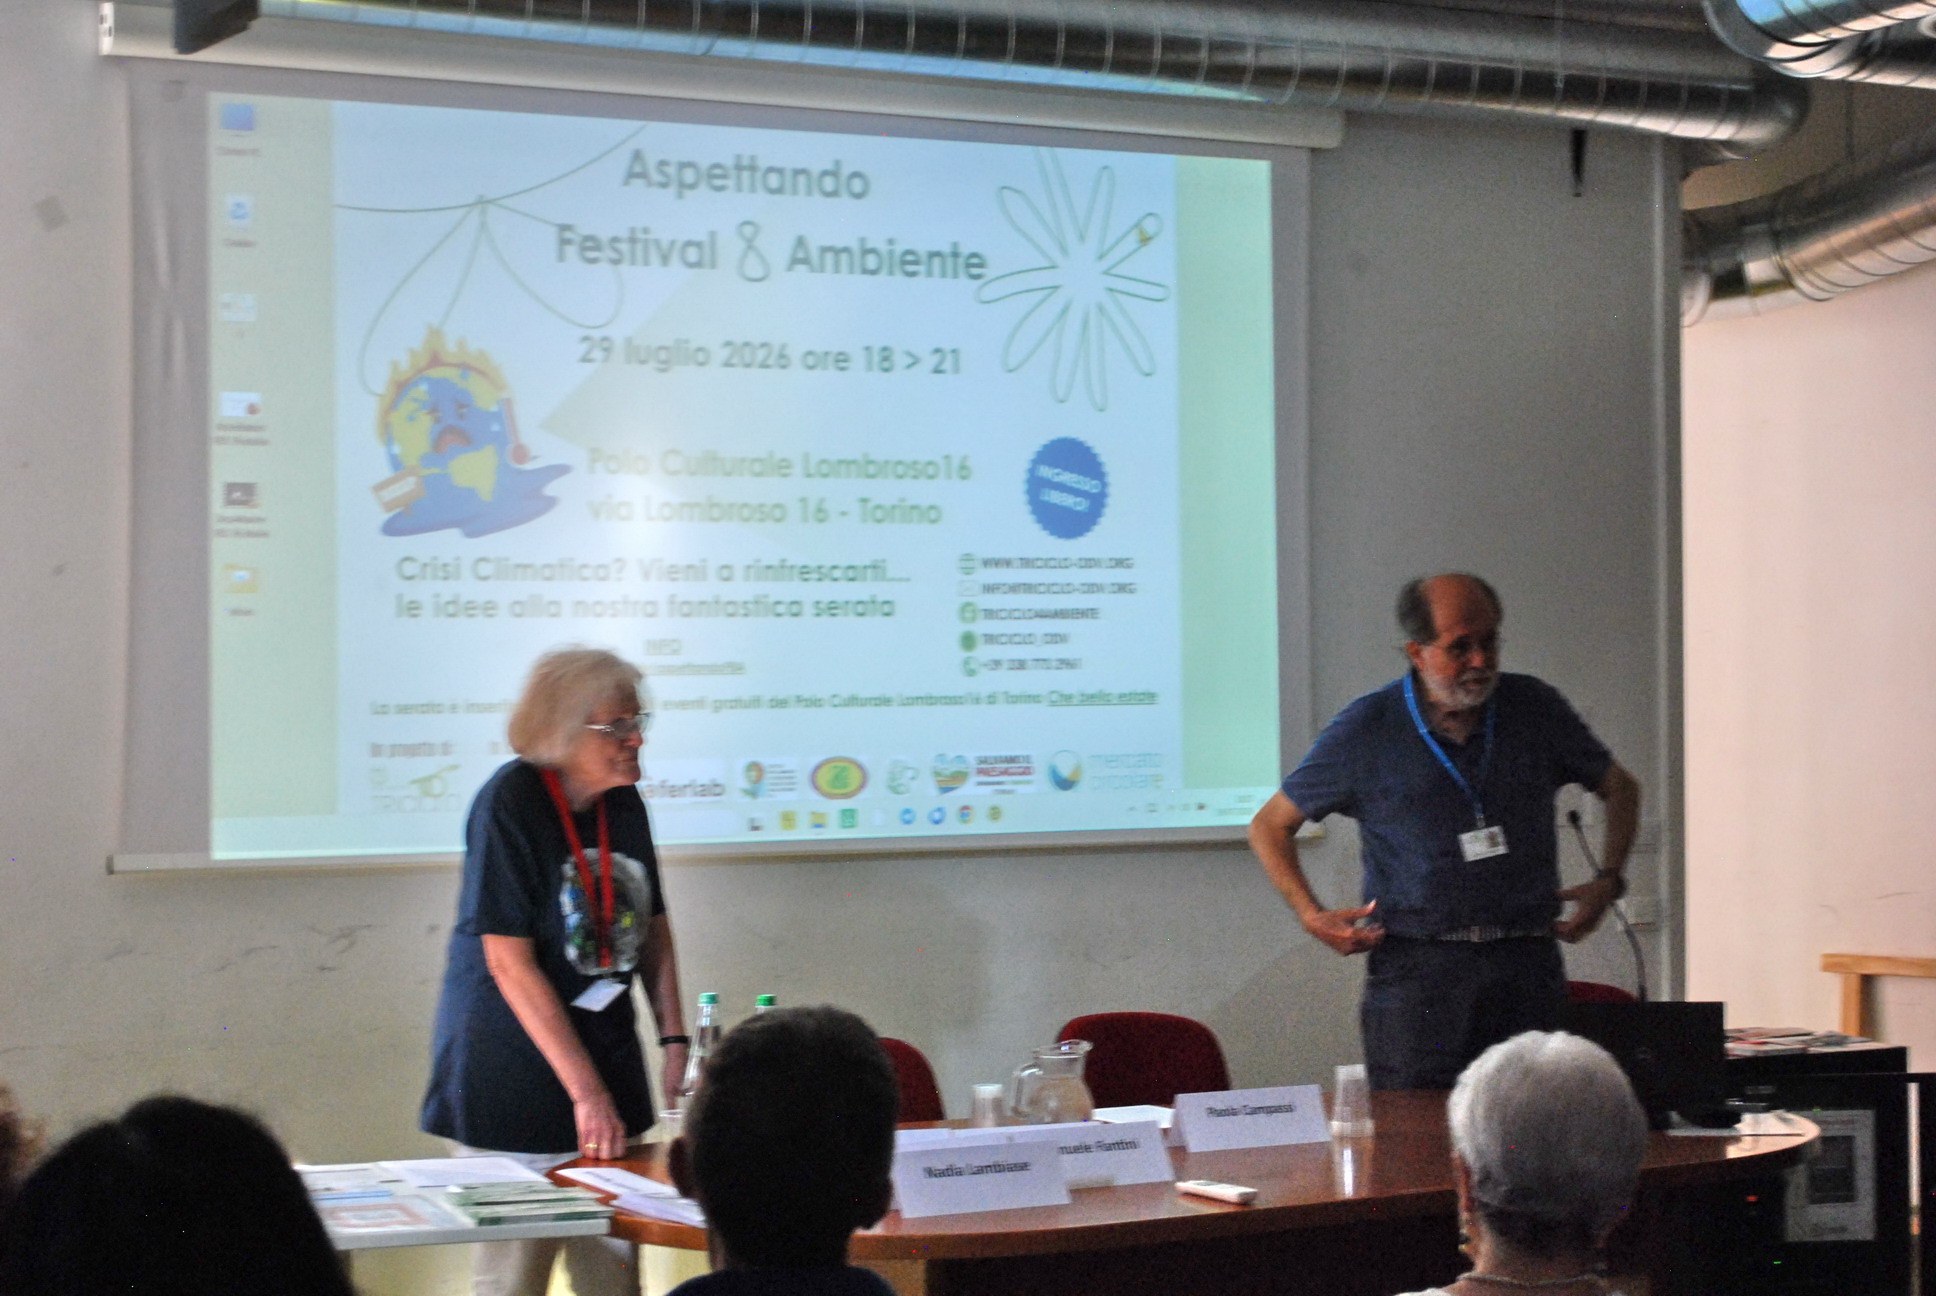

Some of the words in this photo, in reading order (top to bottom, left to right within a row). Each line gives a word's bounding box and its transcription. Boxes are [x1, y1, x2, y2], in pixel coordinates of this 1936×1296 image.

[623, 149, 871, 199] Aspettando
[556, 223, 718, 270] Festival
[786, 234, 987, 280] Ambiente
[579, 335, 614, 364] 29
[624, 337, 711, 373] luglio
[722, 341, 792, 370] 2026
[803, 350, 851, 372] ore
[862, 345, 895, 373] 18
[930, 347, 961, 374] 21
[587, 448, 651, 476] Polo
[660, 449, 793, 478] Culturale
[801, 452, 973, 480] Lombroso16
[586, 494, 634, 522] via
[644, 494, 787, 523] Lombroso
[798, 496, 830, 524] 16
[857, 497, 942, 525] Torino
[396, 556, 461, 582] Crisi
[471, 556, 628, 582] Climatica?
[637, 557, 708, 582] Vieni
[717, 563, 735, 582] a
[395, 593, 422, 618] le
[432, 593, 499, 618] idee
[508, 593, 562, 618] alla
[571, 594, 658, 618] nostra
[667, 594, 804, 618] fantastica
[813, 595, 896, 618] serata
[923, 1164, 965, 1179] Nadia
